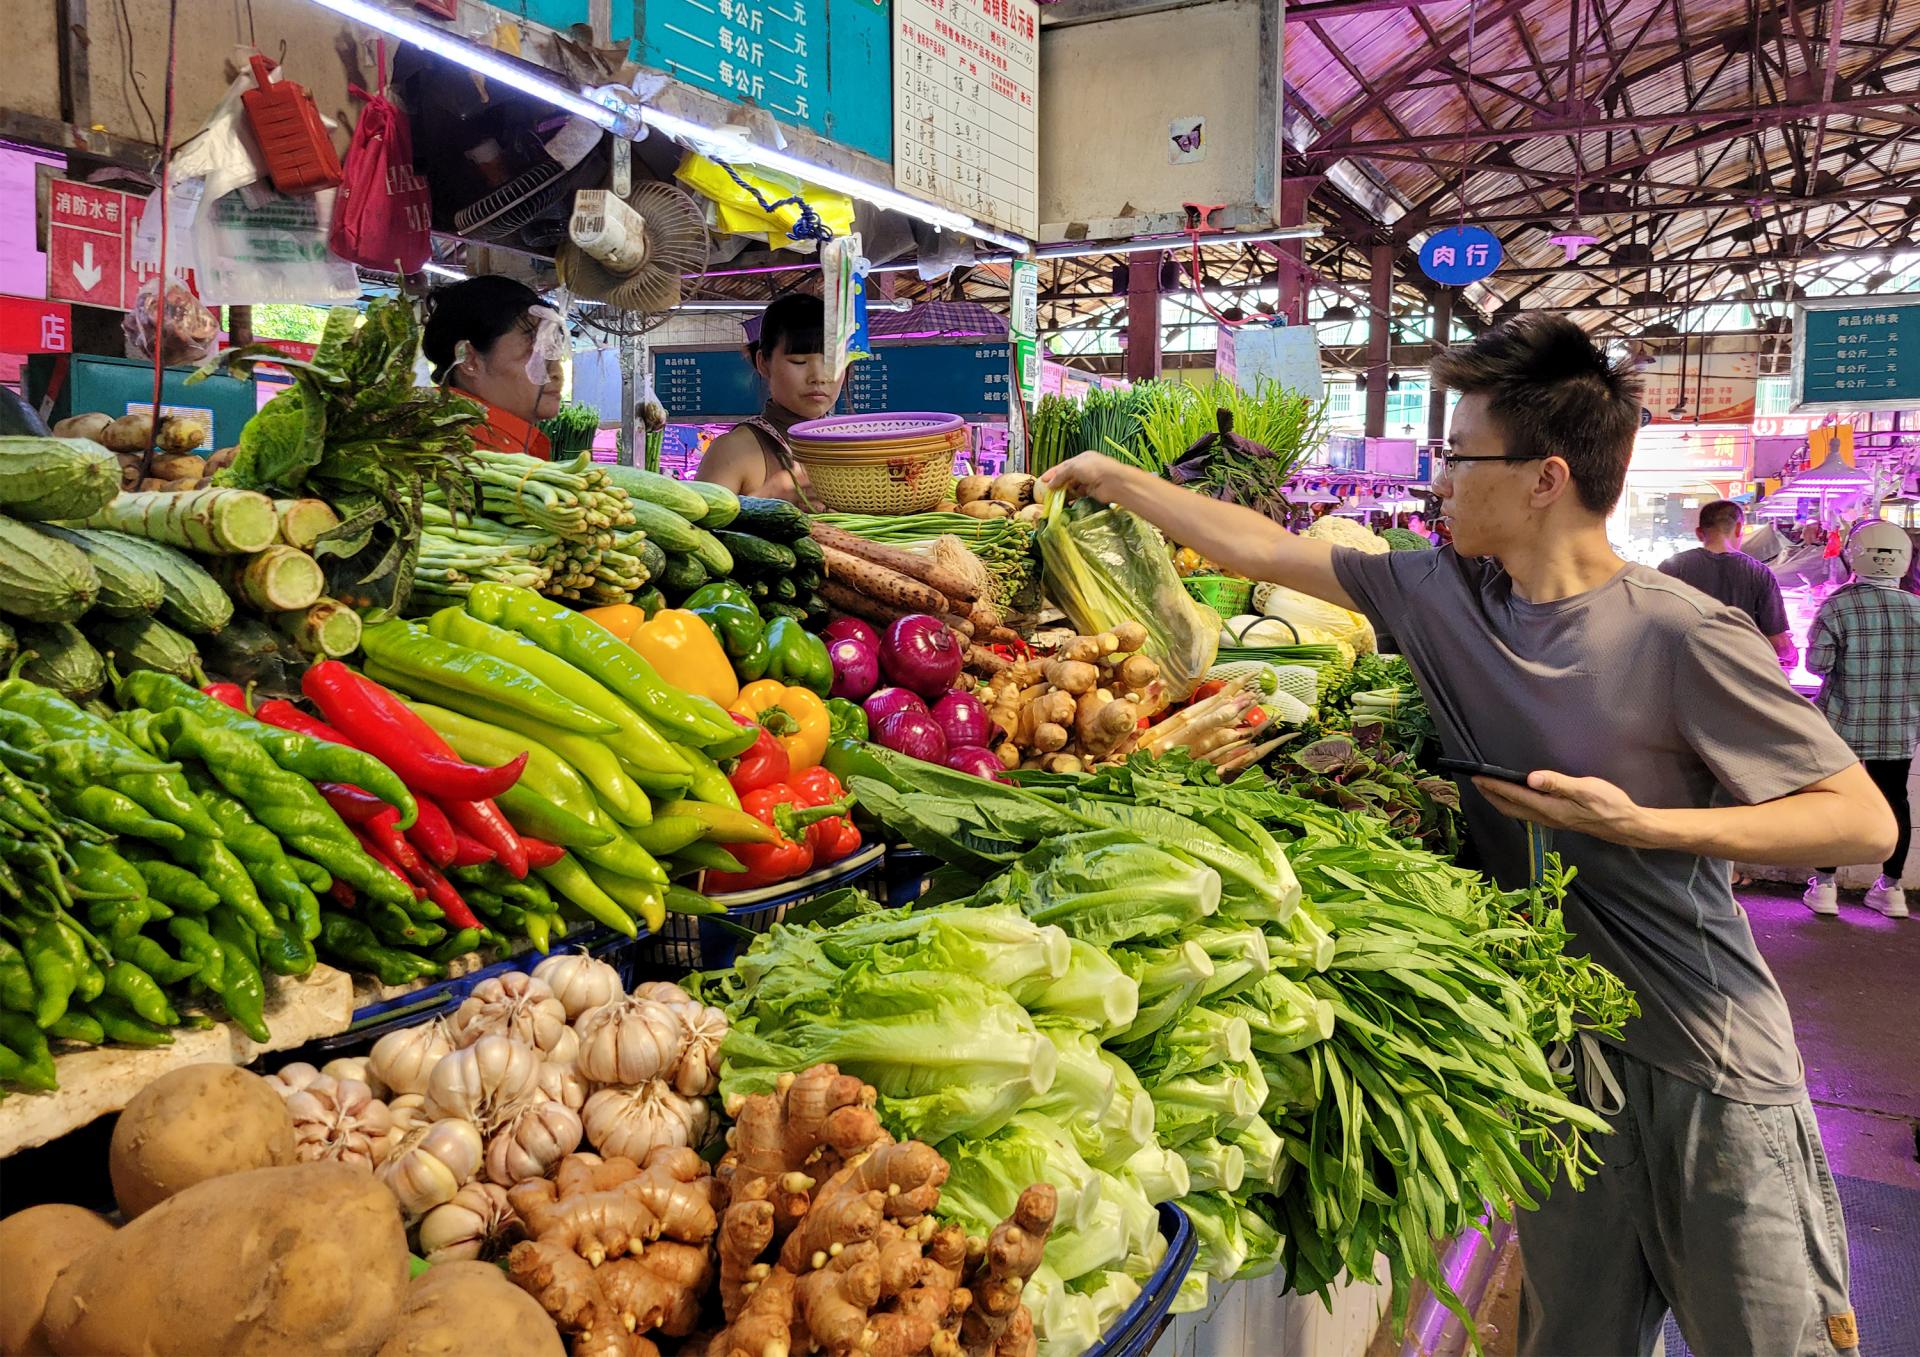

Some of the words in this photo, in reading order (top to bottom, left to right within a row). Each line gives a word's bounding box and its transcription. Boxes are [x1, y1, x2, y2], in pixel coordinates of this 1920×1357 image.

[793, 2, 807, 26] 元
[718, 0, 764, 35] 每公斤
[793, 32, 808, 57] 元
[718, 26, 764, 68] 每公斤
[794, 64, 808, 89] 元
[906, 47, 910, 62] 1
[904, 71, 911, 86] 2
[718, 60, 765, 100] 每公斤
[795, 95, 809, 119] 元
[905, 95, 911, 110] 3
[905, 120, 911, 133] 4
[905, 143, 911, 157] 5
[905, 166, 911, 180] 6
[56, 192, 120, 222] 消防水带
[1432, 244, 1488, 267] 肉行
[1838, 313, 1899, 326] 商品价格表
[41, 313, 65, 350] 店
[1837, 334, 1868, 344] 每公斤
[1888, 332, 1898, 341] 元
[1836, 350, 1868, 358] 每公斤
[1888, 348, 1898, 356] 元
[1836, 364, 1867, 373] 每公斤
[1887, 364, 1896, 372] 元
[1835, 380, 1866, 388] 每公斤
[1886, 378, 1896, 386] 元
